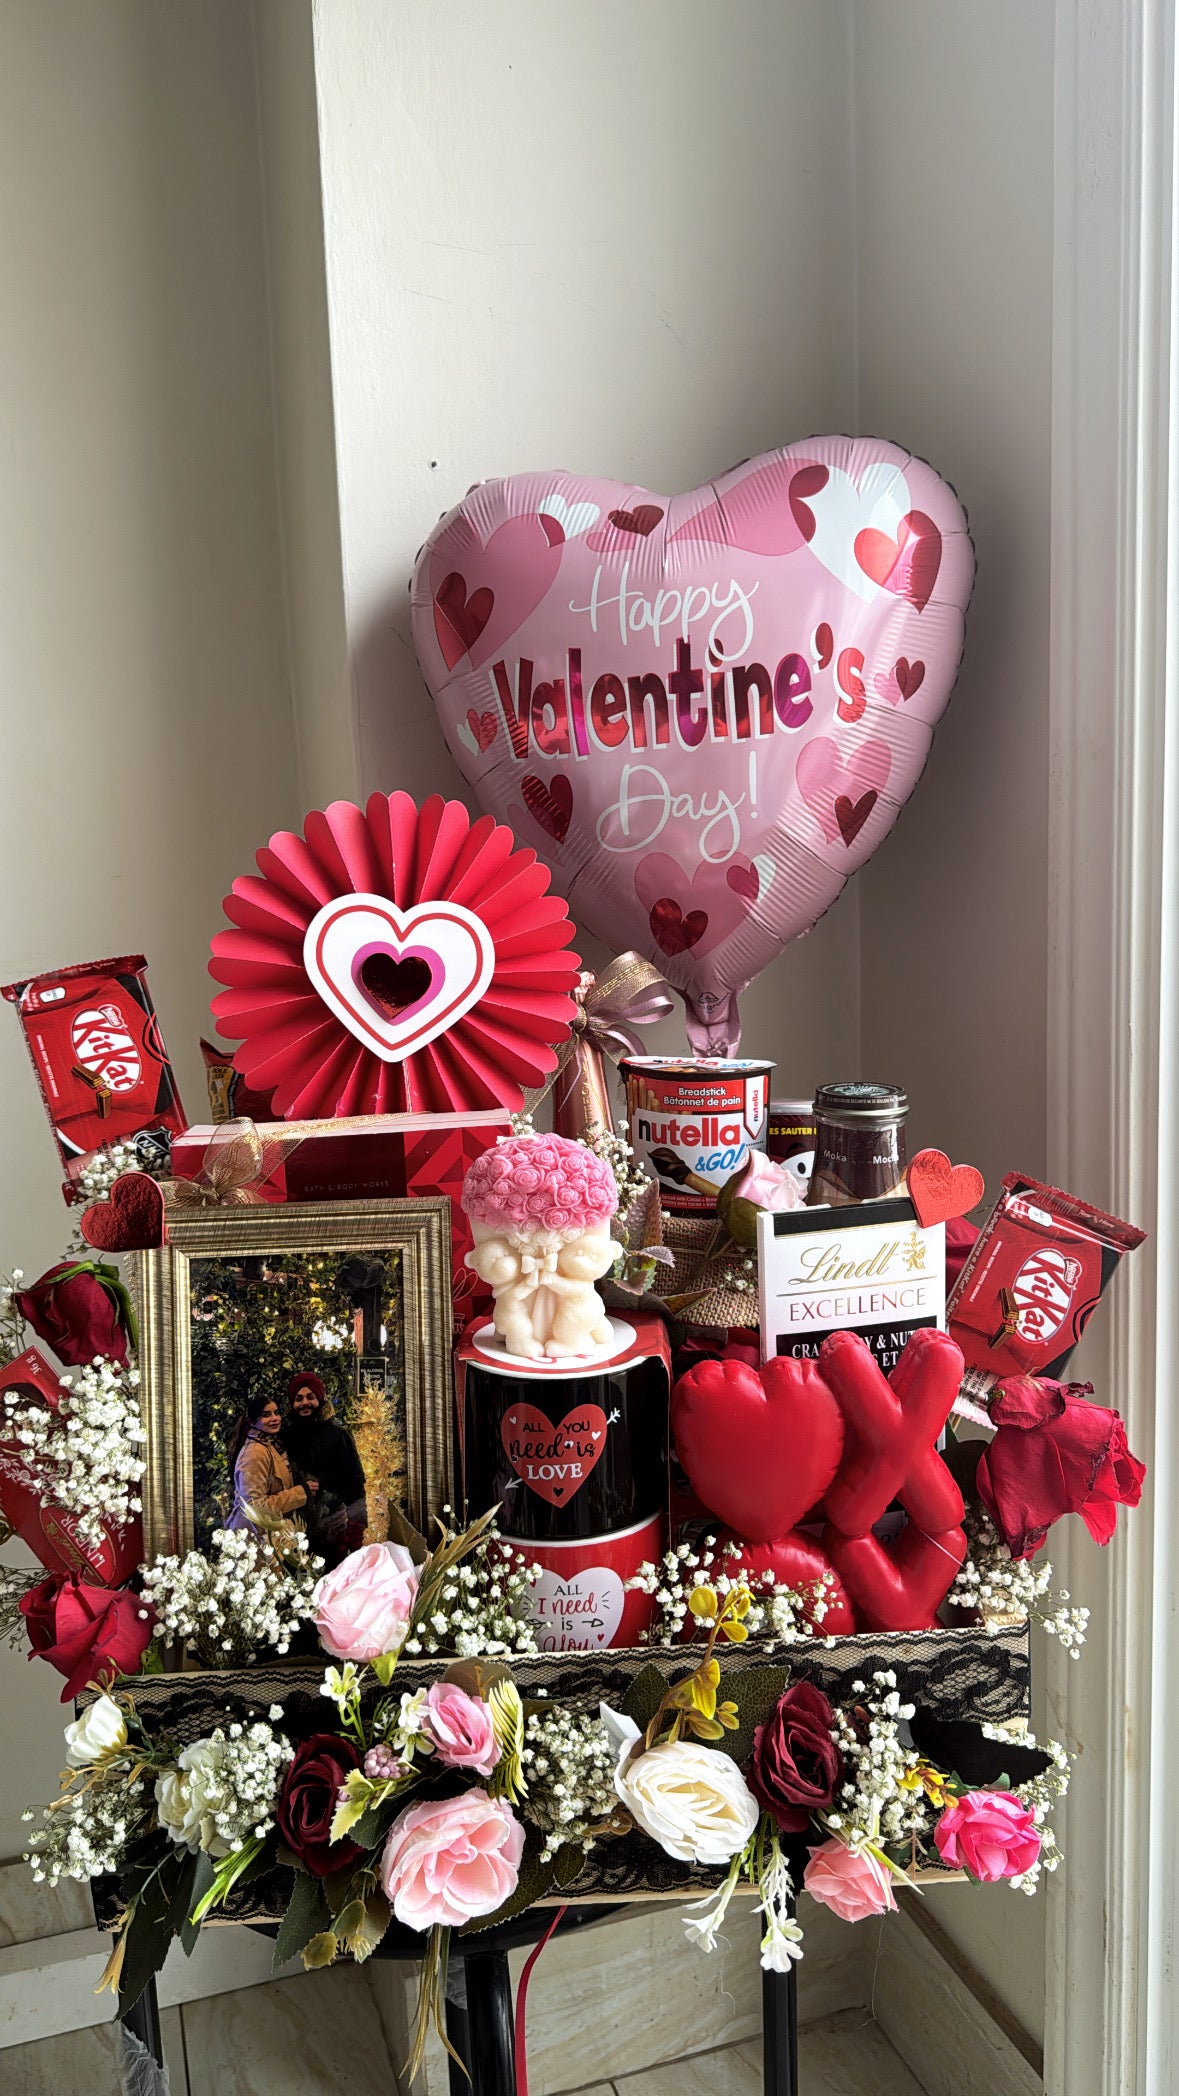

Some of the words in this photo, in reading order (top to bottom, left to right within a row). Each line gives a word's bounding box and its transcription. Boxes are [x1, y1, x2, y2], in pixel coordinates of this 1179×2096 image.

[569, 562, 759, 661] Happy
[489, 622, 867, 764] Valentine's
[596, 751, 759, 864] Day!
[73, 1018, 139, 1089] KitKat
[663, 1096, 705, 1106] Bâtonnet
[707, 1097, 719, 1106] de
[721, 1096, 741, 1108] pain
[678, 1087, 726, 1096] Breadstick
[638, 1117, 740, 1147] nutella
[781, 1127, 812, 1135] SAUTER
[695, 1143, 746, 1172] &GO!
[823, 1149, 847, 1162] Moka
[788, 1241, 902, 1285] Lindt
[790, 1288, 926, 1322] EXCELLENCE
[1013, 1255, 1071, 1339] KitKat
[876, 1334, 886, 1349] &
[882, 1351, 899, 1367] ET
[522, 1422, 546, 1432] ALL
[563, 1420, 590, 1434] YOU
[509, 1432, 564, 1461] need
[576, 1441, 597, 1458] is
[526, 1463, 583, 1480] LOVE
[554, 1584, 583, 1596] ALL
[538, 1597, 546, 1614] I
[552, 1592, 597, 1616] need
[561, 1617, 573, 1631] is
